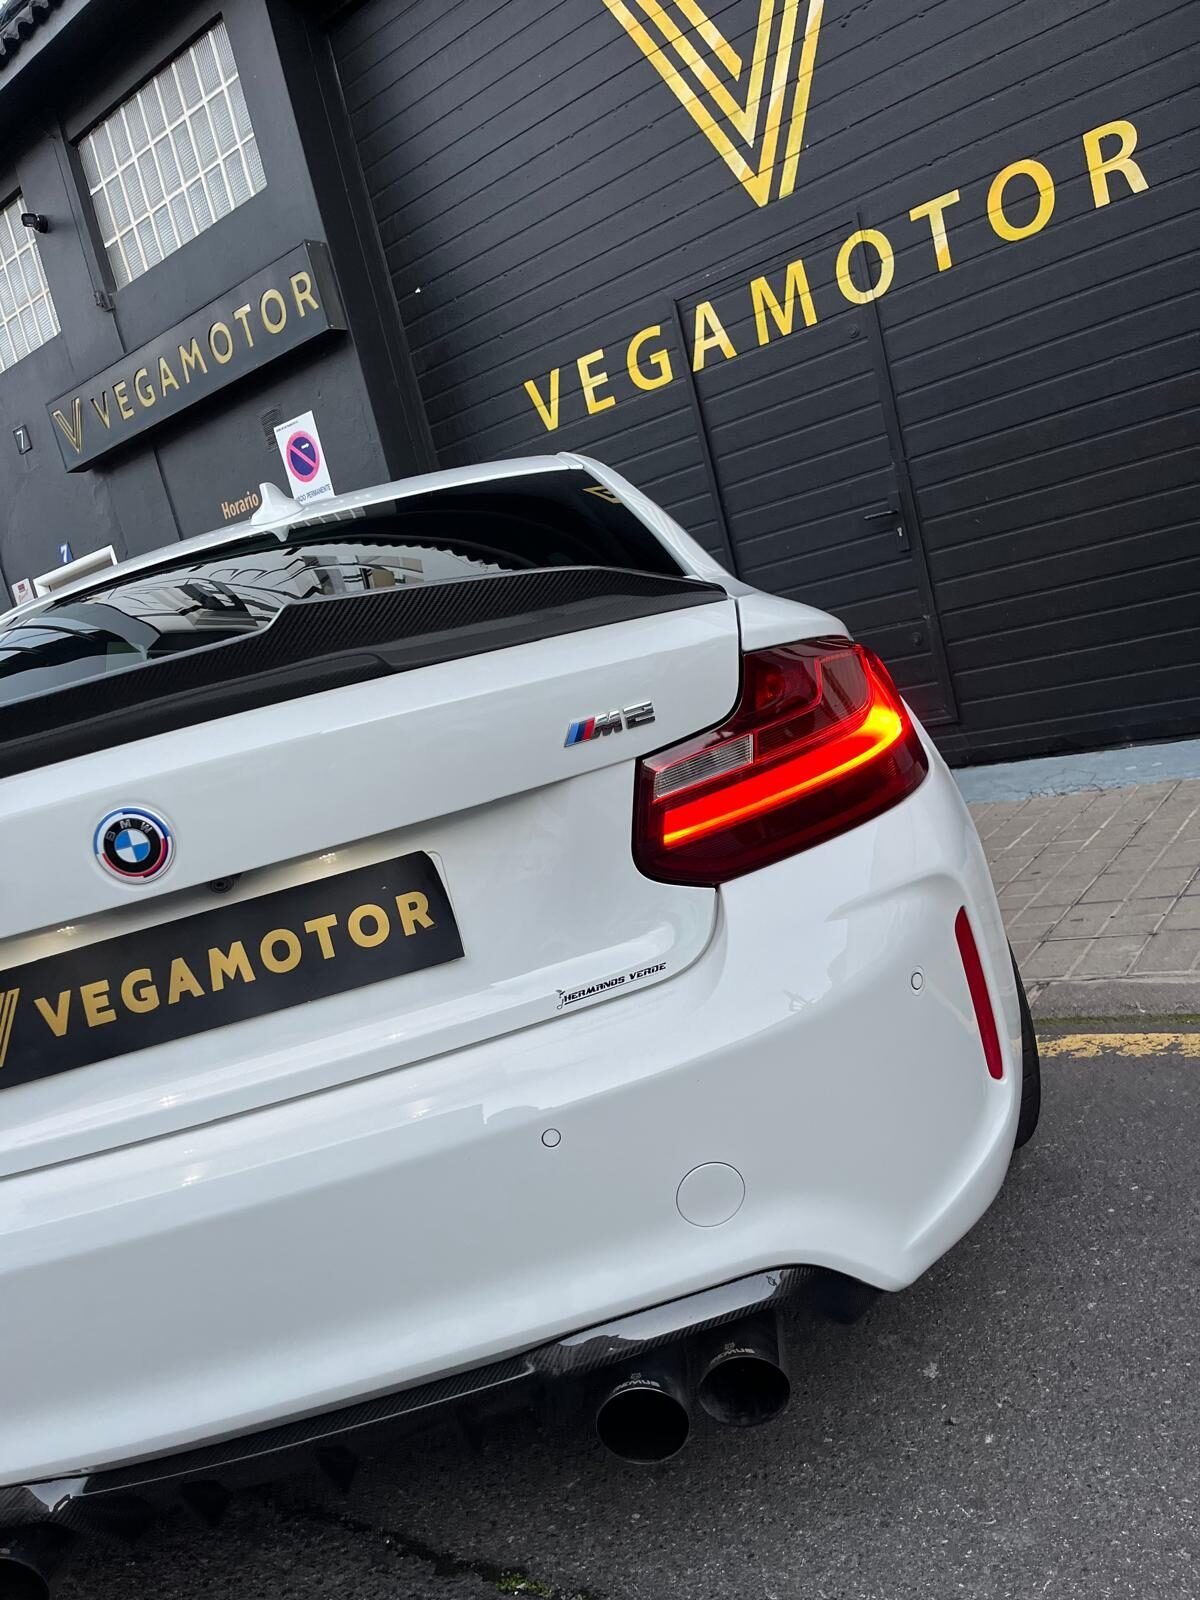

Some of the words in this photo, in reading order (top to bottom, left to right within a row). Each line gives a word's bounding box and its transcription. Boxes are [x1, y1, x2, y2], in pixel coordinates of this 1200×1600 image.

[523, 119, 1150, 431] VEGAMOTOR
[90, 271, 320, 430] VEGAMOTOR
[16, 430, 25, 449] 7
[221, 491, 259, 520] Horario
[60, 544, 69, 564] 7
[590, 700, 656, 740] M2
[105, 819, 153, 842] BMW
[34, 890, 435, 1037] VEGAMOTOR
[563, 975, 626, 1003] HERMANOS
[629, 962, 667, 981] VERDE
